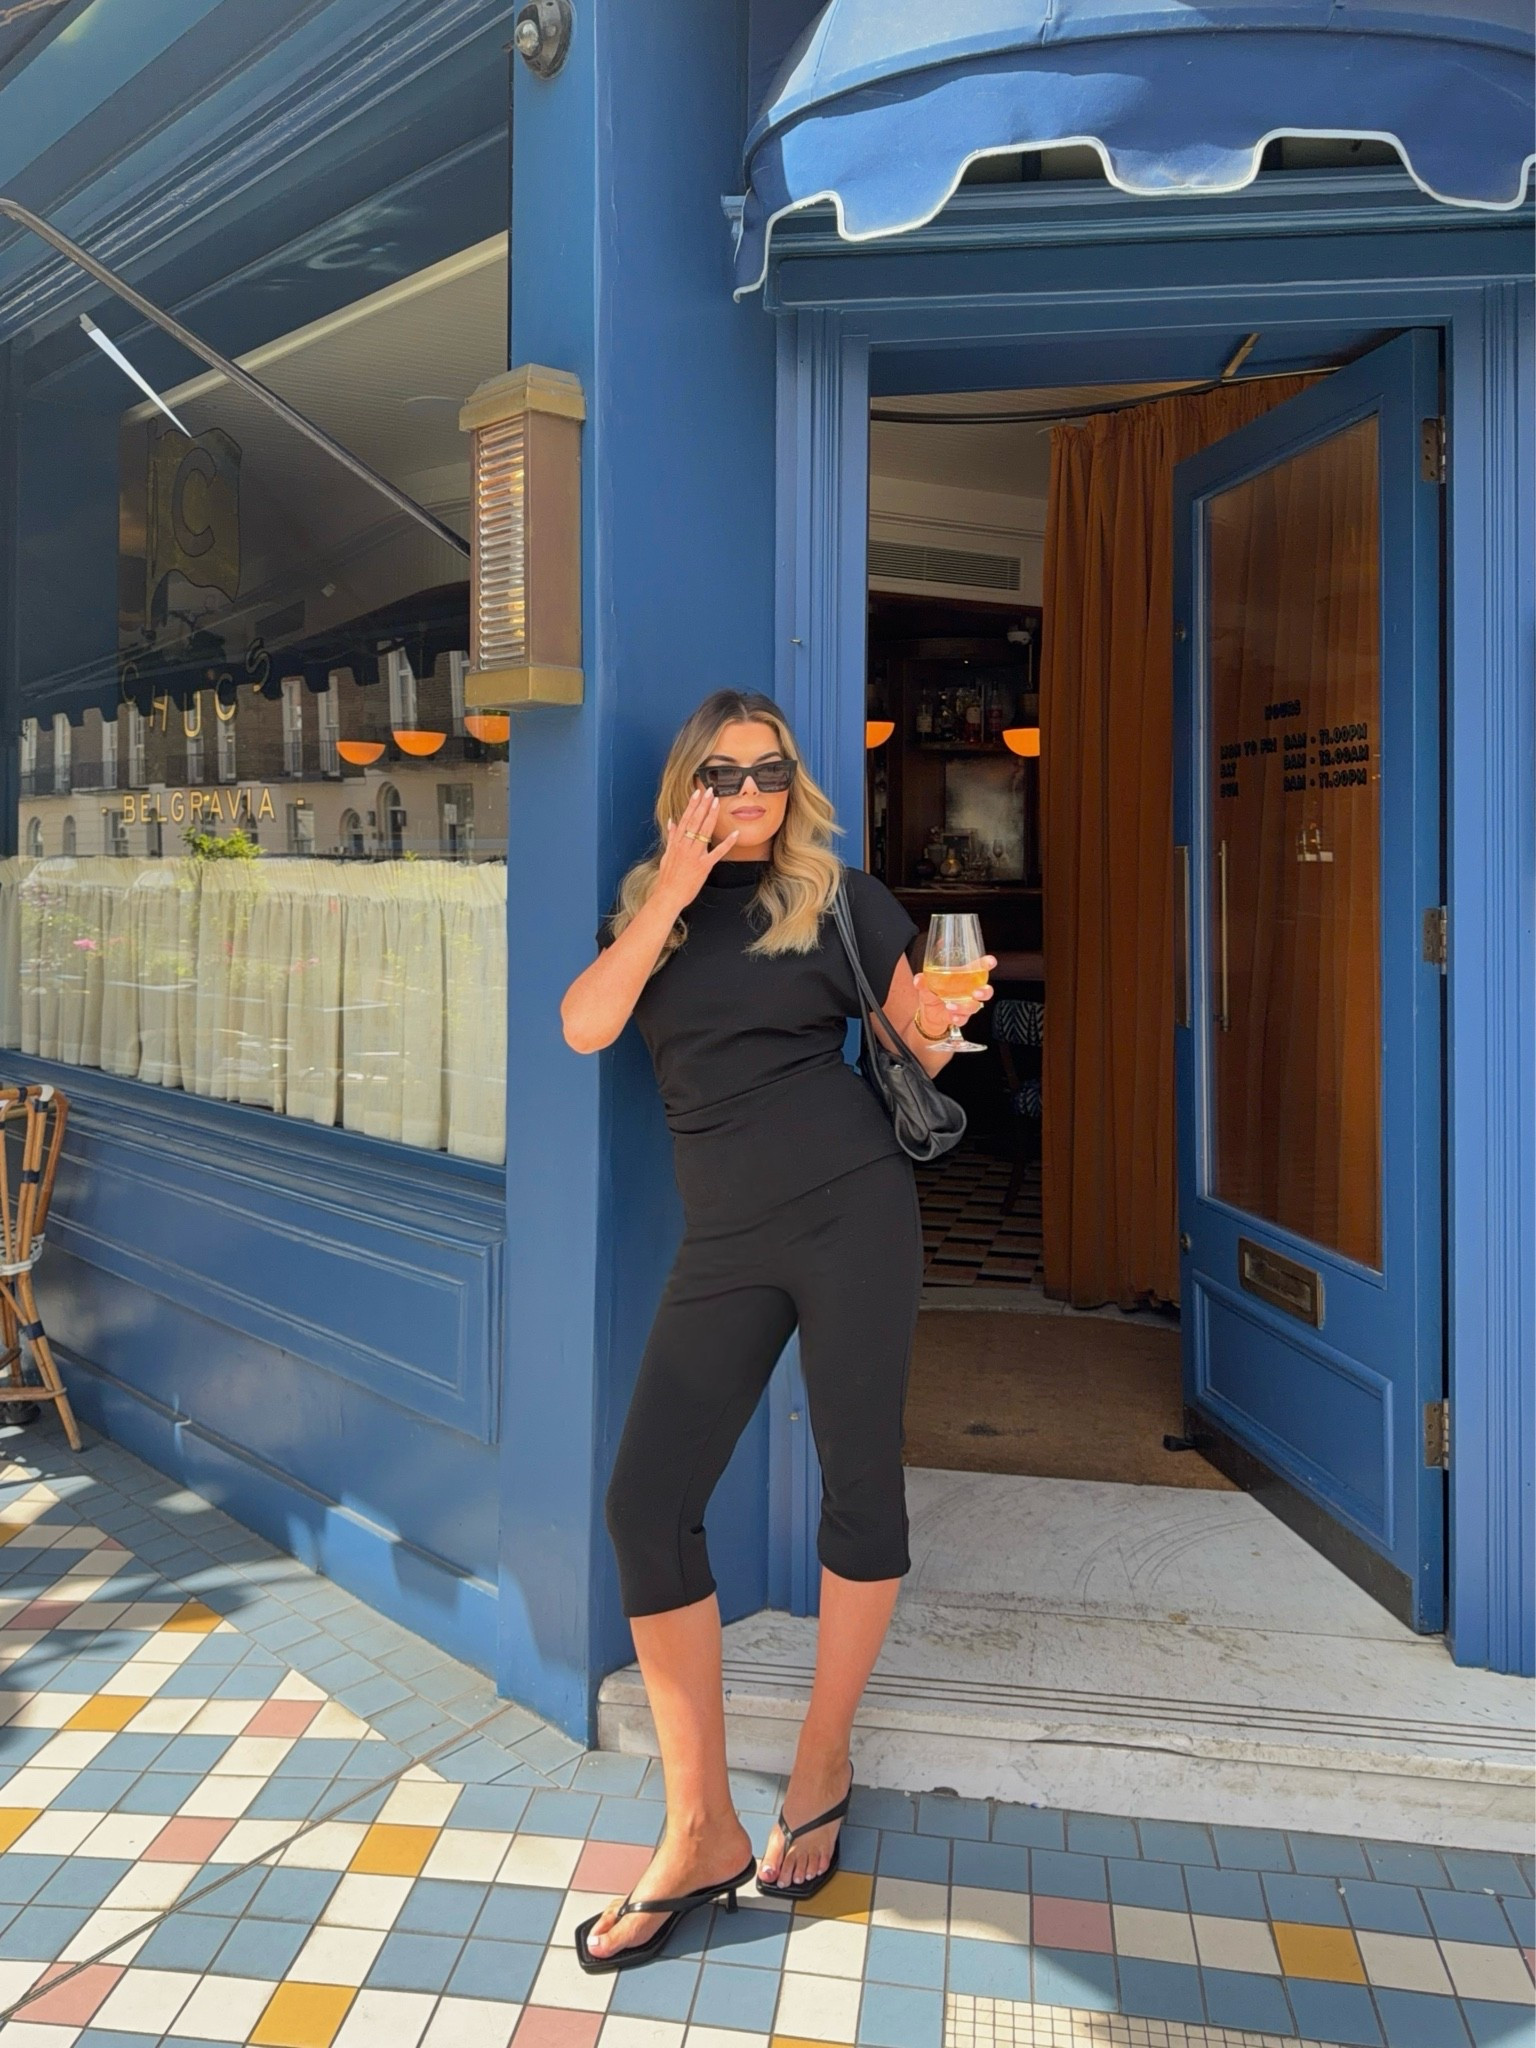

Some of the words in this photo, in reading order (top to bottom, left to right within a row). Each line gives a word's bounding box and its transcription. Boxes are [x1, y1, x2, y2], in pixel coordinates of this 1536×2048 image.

[173, 447, 218, 559] C
[121, 637, 272, 738] CHUCS
[1319, 722, 1368, 746] 11.00PM
[122, 787, 276, 825] BELGRAVIA
